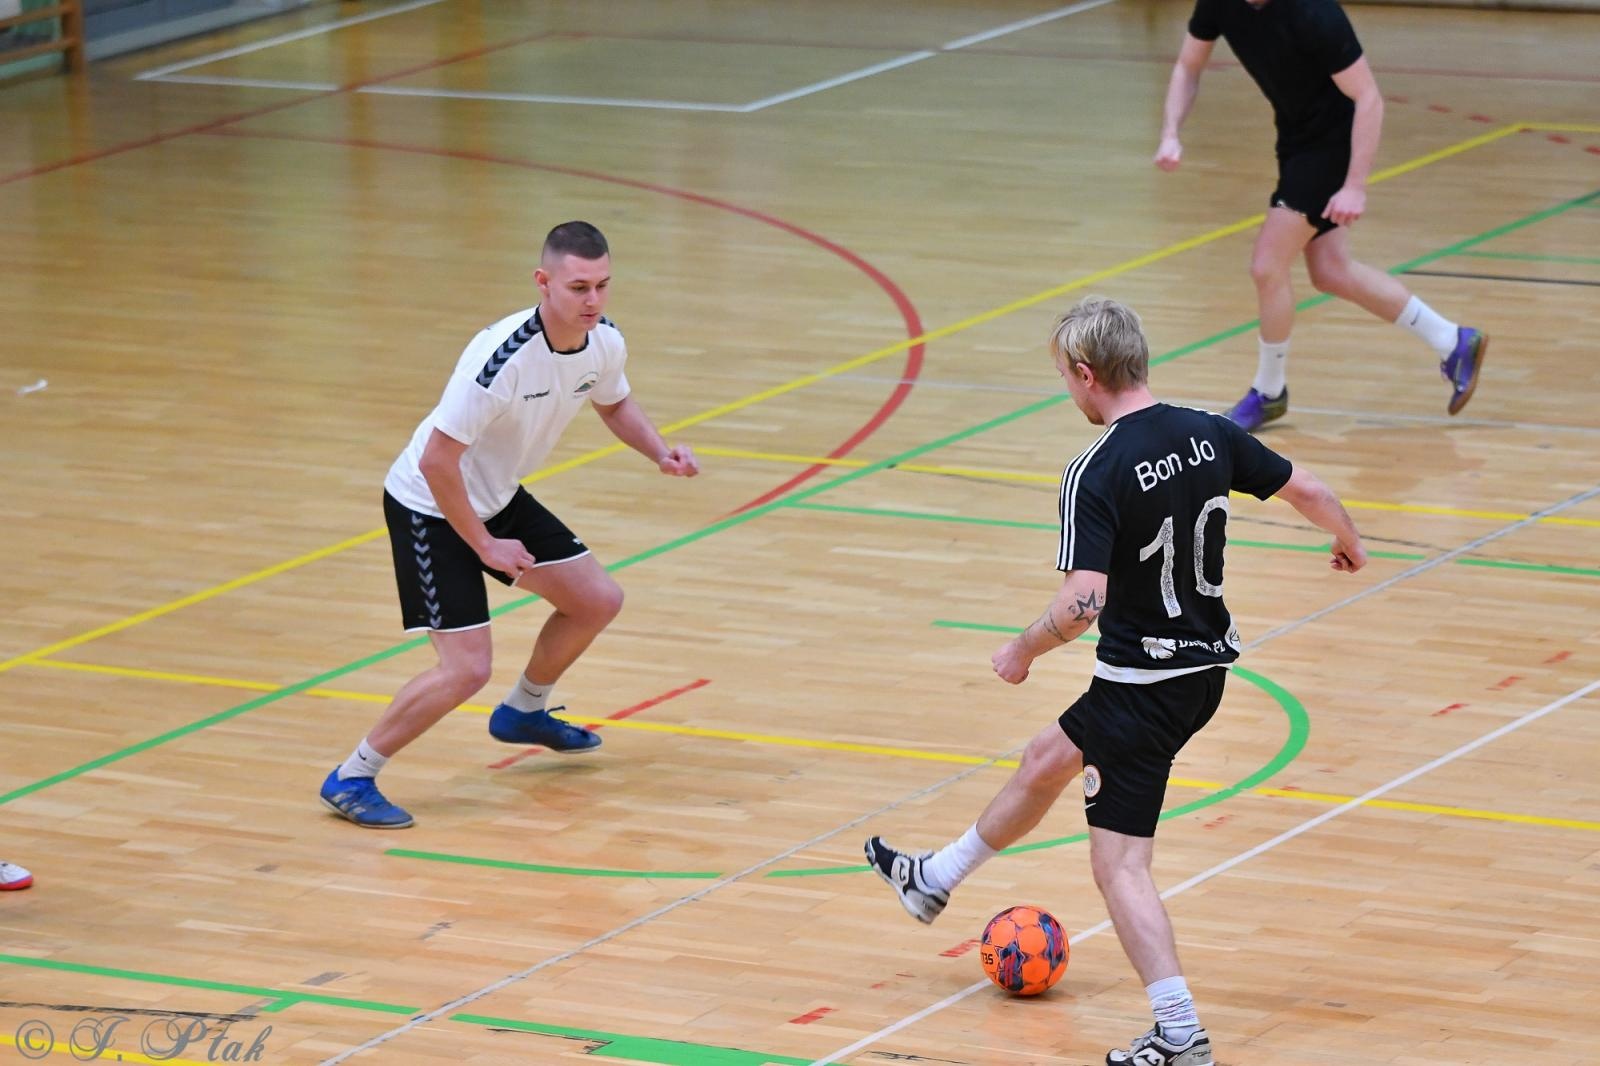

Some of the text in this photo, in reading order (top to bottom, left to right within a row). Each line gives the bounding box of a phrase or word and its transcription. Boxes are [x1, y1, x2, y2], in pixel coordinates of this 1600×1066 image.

[1134, 437, 1216, 492] Bon Jo
[1139, 495, 1231, 618] 10
